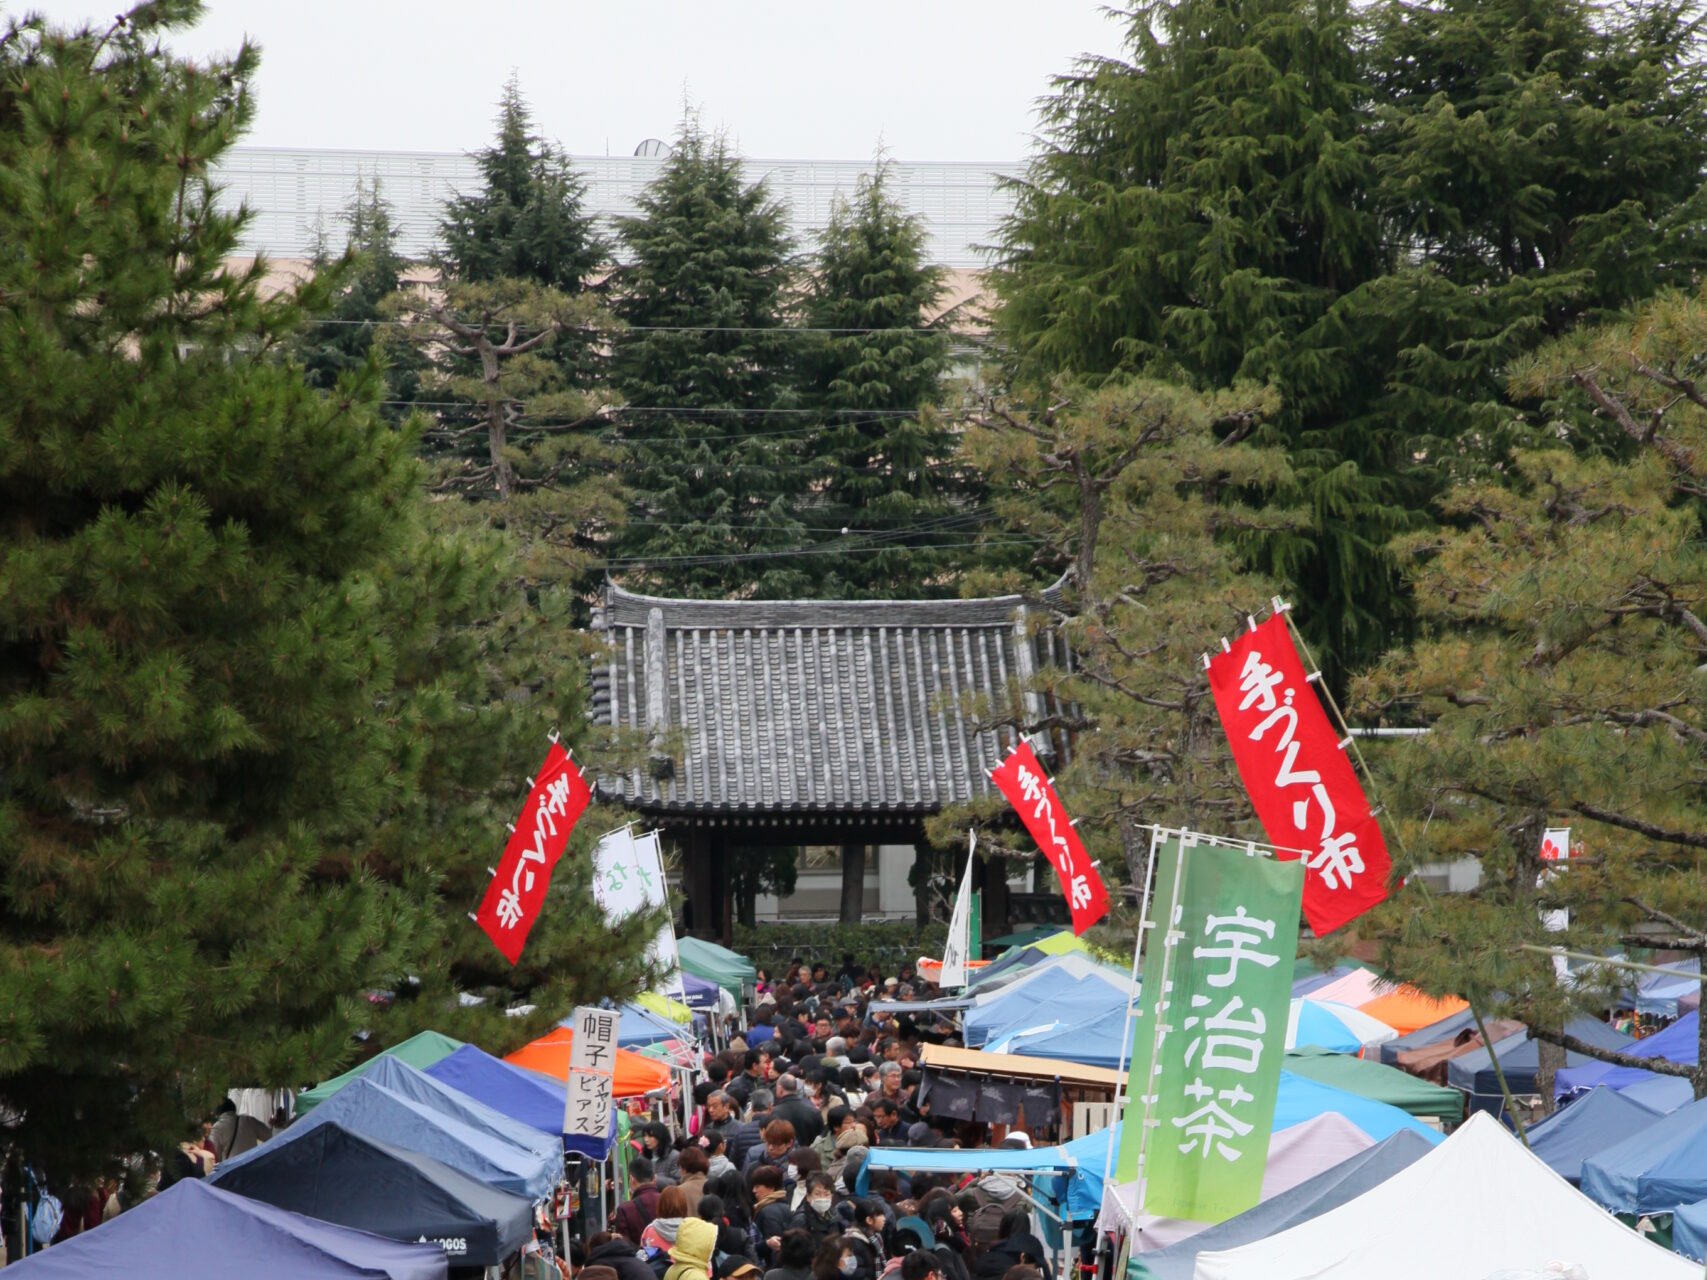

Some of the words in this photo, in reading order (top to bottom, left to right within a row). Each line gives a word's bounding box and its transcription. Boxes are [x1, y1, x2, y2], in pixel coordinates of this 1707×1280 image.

[1238, 651, 1365, 890] 手づくり市
[1018, 765, 1092, 910] 手づくり市
[583, 1013, 613, 1067] 帽子
[1171, 905, 1281, 1162] 宇治茶
[576, 1076, 597, 1132] ピアス
[591, 1076, 611, 1136] イヤリング
[433, 1238, 467, 1250] OGOS
